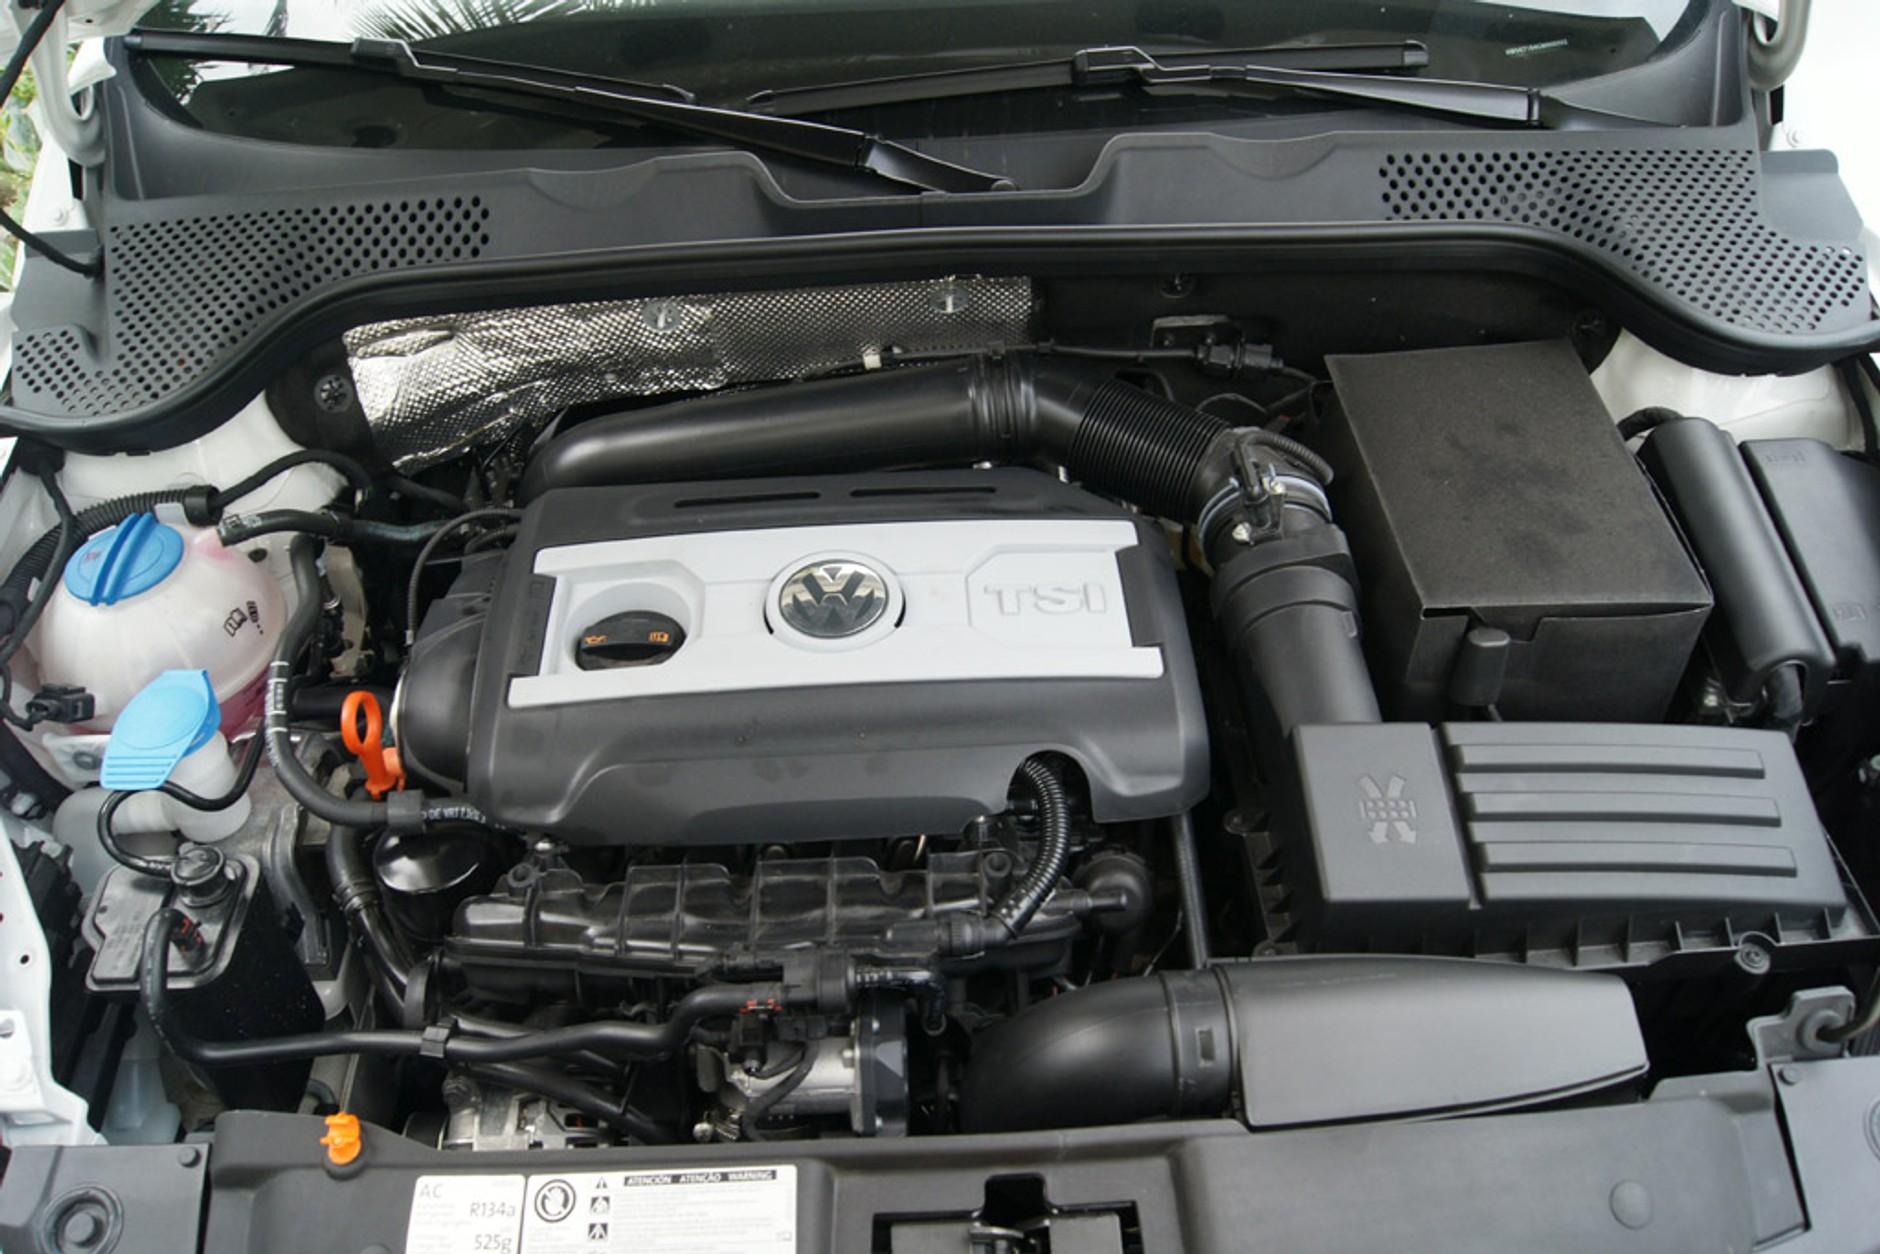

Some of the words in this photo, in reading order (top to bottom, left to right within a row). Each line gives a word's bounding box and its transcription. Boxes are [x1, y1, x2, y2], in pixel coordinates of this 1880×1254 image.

[780, 559, 888, 638] VW
[984, 582, 1107, 616] TSI
[679, 1172, 721, 1184] ATENÇÃO
[727, 1170, 773, 1181] WARNING
[419, 1183, 443, 1198] AC
[470, 1202, 516, 1217] R134a
[474, 1233, 513, 1254] 525g
